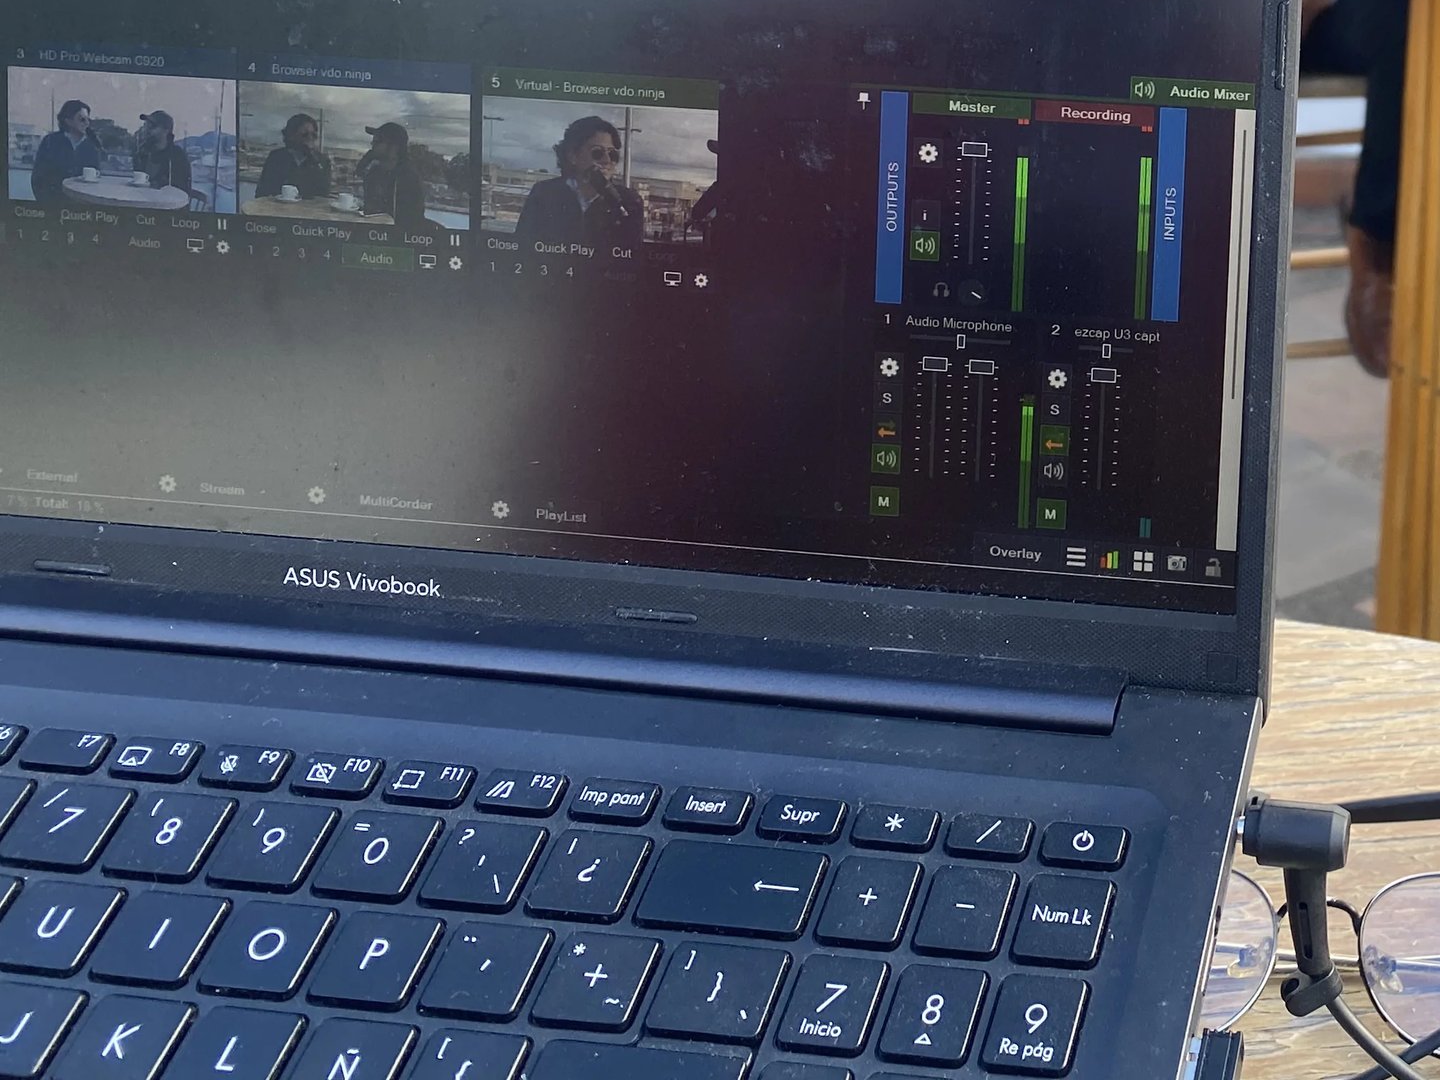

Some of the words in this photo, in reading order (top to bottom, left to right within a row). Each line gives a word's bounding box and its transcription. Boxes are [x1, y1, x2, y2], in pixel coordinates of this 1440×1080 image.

[16, 48, 25, 59] 3
[39, 50, 57, 61] HD
[60, 51, 79, 63] Pro
[84, 52, 131, 66] Webcam
[135, 56, 165, 68] C920
[248, 62, 256, 73] 4
[272, 63, 317, 77] Browser
[491, 77, 500, 88] 5
[515, 78, 552, 91] Virtual
[563, 82, 609, 95] Browser
[1170, 85, 1210, 99] Audio
[1214, 88, 1251, 102] Mixer
[949, 100, 996, 114] Master
[1060, 106, 1131, 124] Recording
[886, 162, 900, 232] OUTPUTS
[14, 206, 45, 218] Close
[60, 209, 93, 223] Quick
[95, 211, 119, 225] Play
[136, 214, 156, 226] Cut
[1163, 187, 1177, 241] INPUTS
[171, 217, 200, 230] Loop
[245, 222, 277, 234] Close
[292, 224, 324, 237] Quick
[327, 227, 351, 240] Play
[128, 236, 161, 249] Audio
[369, 230, 388, 241] Cut
[404, 232, 433, 246] Loop
[487, 237, 519, 251] Close
[272, 246, 280, 257] 2
[298, 248, 306, 259] 3
[323, 249, 331, 261] 4
[360, 251, 393, 265] Audio
[534, 241, 567, 254] Quick
[570, 244, 595, 258] Play
[612, 247, 632, 259] Cut
[490, 261, 496, 271] 1
[514, 263, 523, 274] 2
[540, 265, 548, 276] 3
[566, 266, 574, 278] 4
[884, 314, 891, 324] 1
[906, 314, 940, 328] Audio
[943, 316, 1013, 333] Microphone
[1051, 324, 1061, 336] 2
[1074, 328, 1110, 341] ezcap
[1114, 328, 1131, 340] U3
[1134, 331, 1160, 344] capt
[882, 392, 892, 404] S
[1050, 404, 1060, 416] S
[26, 469, 78, 483] External
[200, 482, 245, 496] Stream
[360, 495, 433, 510] MultiCorder
[878, 496, 890, 508] M
[536, 508, 587, 523] PlayList
[1045, 509, 1056, 520] M
[989, 545, 1042, 562] Overlay
[283, 566, 341, 589] ASUS
[346, 571, 441, 598] Vivobook
[77, 734, 102, 749] F7
[169, 742, 191, 757] F8
[258, 750, 280, 765] F9
[343, 758, 372, 773] F10
[440, 767, 465, 782] F11
[531, 775, 556, 790] F12
[579, 786, 606, 805] Imp
[609, 790, 646, 807] pant
[685, 795, 727, 815] Insert
[48, 807, 86, 834] 7
[781, 804, 820, 824] Supr
[155, 817, 182, 845] 8
[457, 828, 475, 845] ?
[262, 827, 286, 854] 9
[363, 837, 390, 865] 0
[858, 887, 878, 906] +
[37, 904, 76, 939] U
[1031, 904, 1069, 924] Num
[1073, 908, 1092, 926] Lk
[248, 928, 286, 961] O
[360, 938, 390, 970] P
[584, 963, 608, 987] +
[816, 982, 848, 1013] 7
[921, 994, 944, 1025] 8
[0, 1011, 34, 1043] J
[1025, 1003, 1048, 1034] 9
[799, 1018, 842, 1038] Inicio
[102, 1023, 144, 1059] K
[215, 1036, 239, 1072] L
[1000, 1037, 1019, 1056] Re
[1022, 1039, 1054, 1063] pág
[327, 1048, 361, 1080] Ñ
